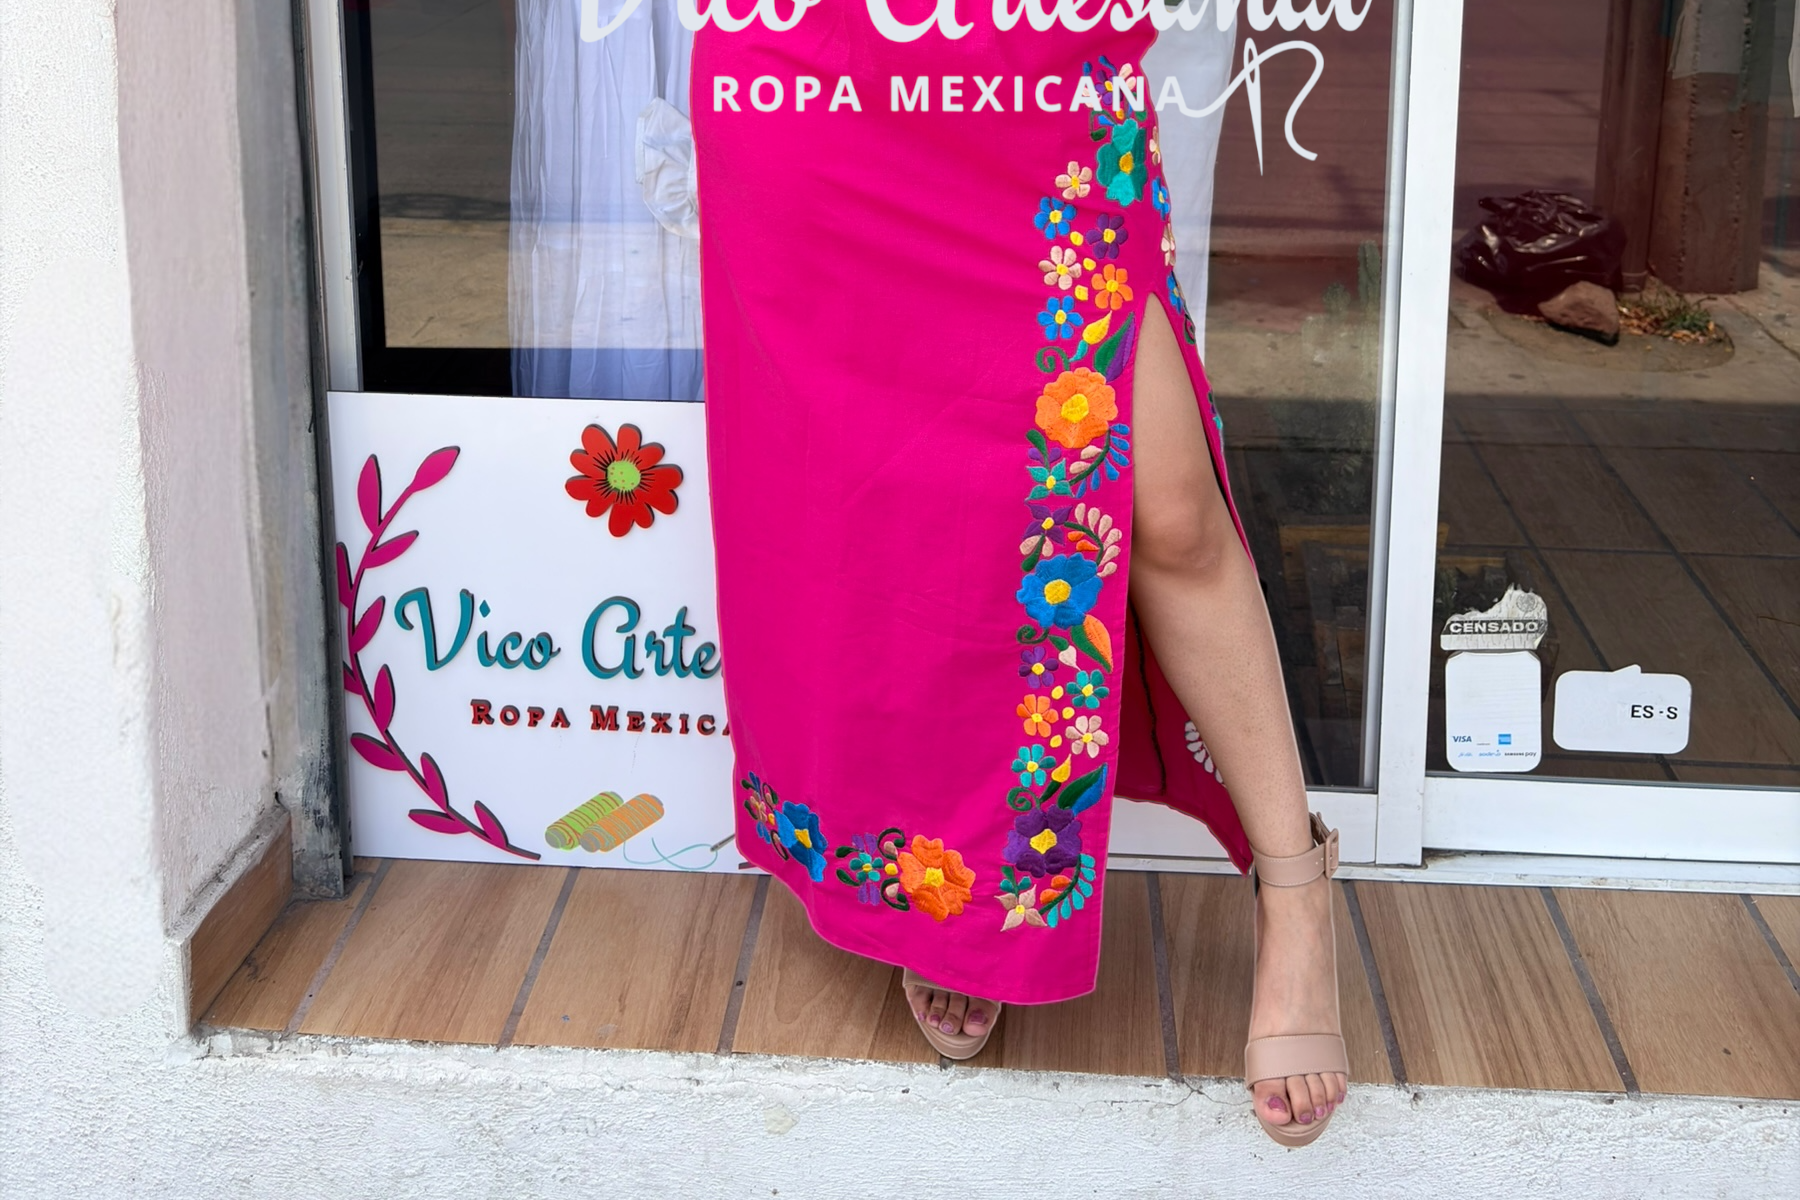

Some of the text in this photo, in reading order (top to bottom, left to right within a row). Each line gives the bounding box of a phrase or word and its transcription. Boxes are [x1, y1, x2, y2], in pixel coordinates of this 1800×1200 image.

[394, 586, 724, 680] Vico Arte
[1449, 621, 1539, 633] CENSADO
[1452, 735, 1472, 743] VISA
